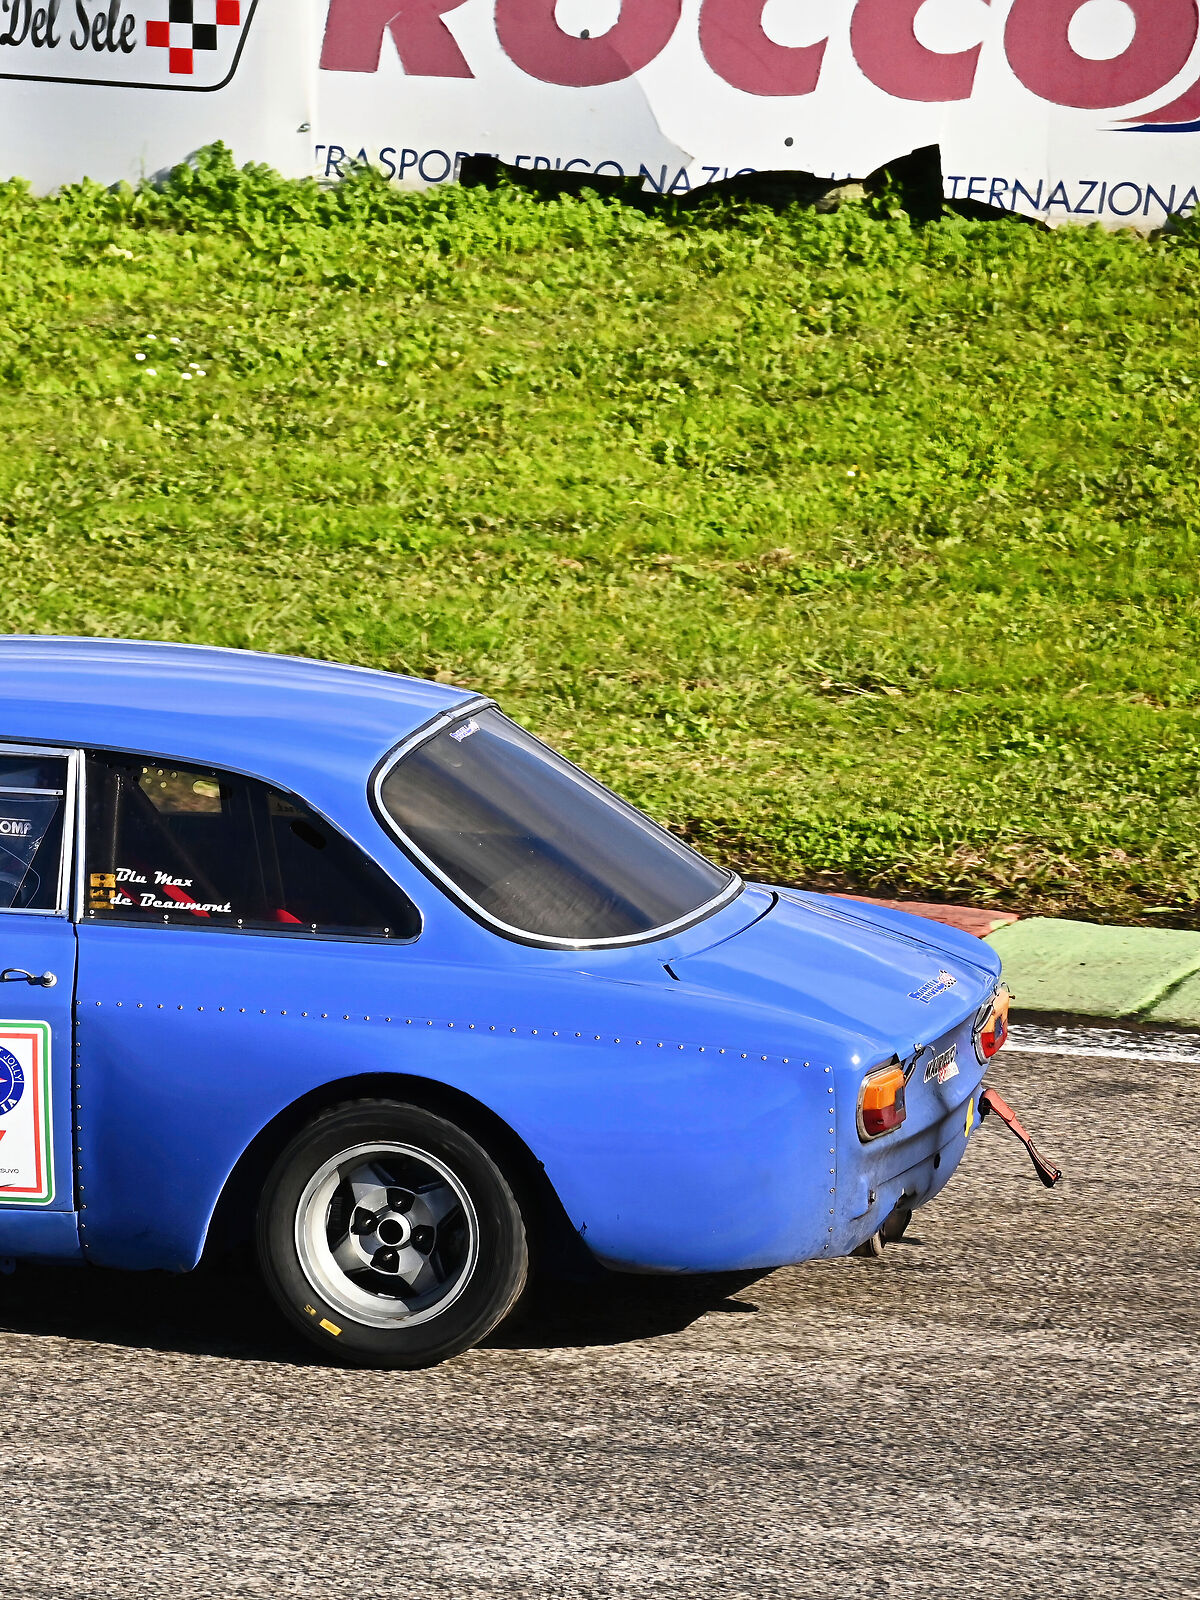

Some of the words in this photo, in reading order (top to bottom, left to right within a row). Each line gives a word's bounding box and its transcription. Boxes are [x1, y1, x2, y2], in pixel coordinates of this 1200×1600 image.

[0, 0, 60, 47] Del
[70, 0, 136, 53] Sele
[0, 819, 33, 835] OMP
[116, 867, 148, 884] Blu
[154, 871, 194, 887] Max
[109, 893, 133, 906] de
[139, 893, 232, 913] Beaumont
[3, 1054, 23, 1081] JOLLY
